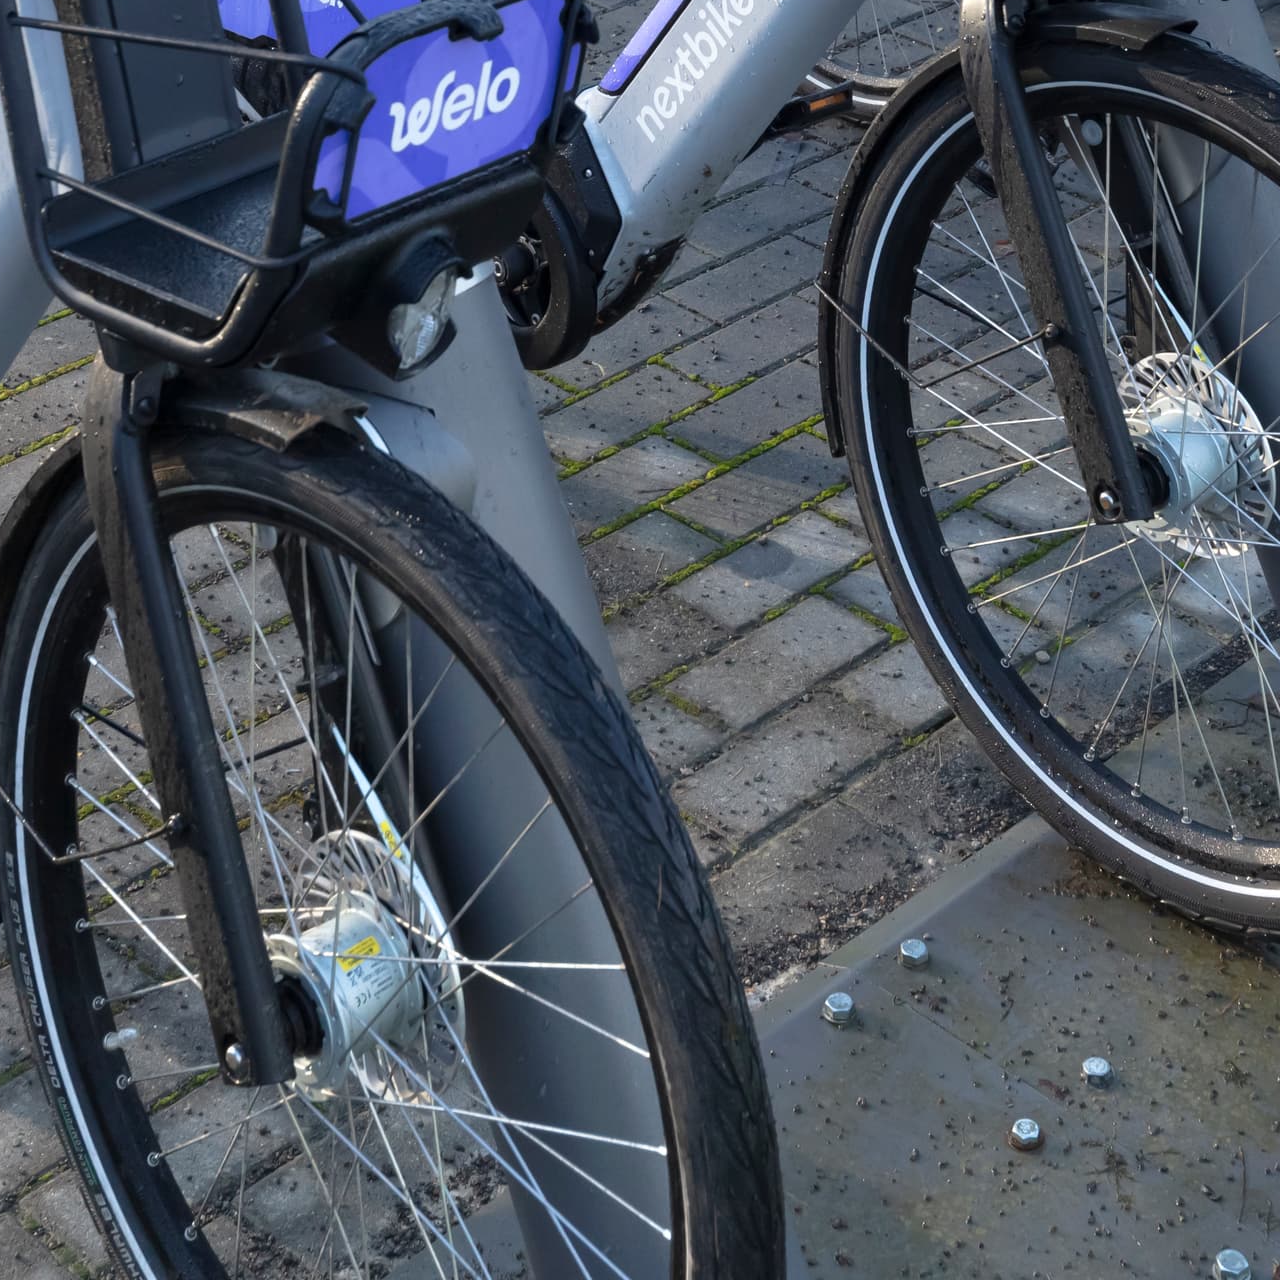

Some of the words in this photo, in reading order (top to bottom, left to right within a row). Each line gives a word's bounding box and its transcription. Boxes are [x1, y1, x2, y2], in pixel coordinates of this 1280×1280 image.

[389, 60, 520, 153] Welo
[19, 951, 43, 1027] CRUISER
[38, 1034, 61, 1089] DELTA
[94, 1193, 143, 1280] HWALBE
